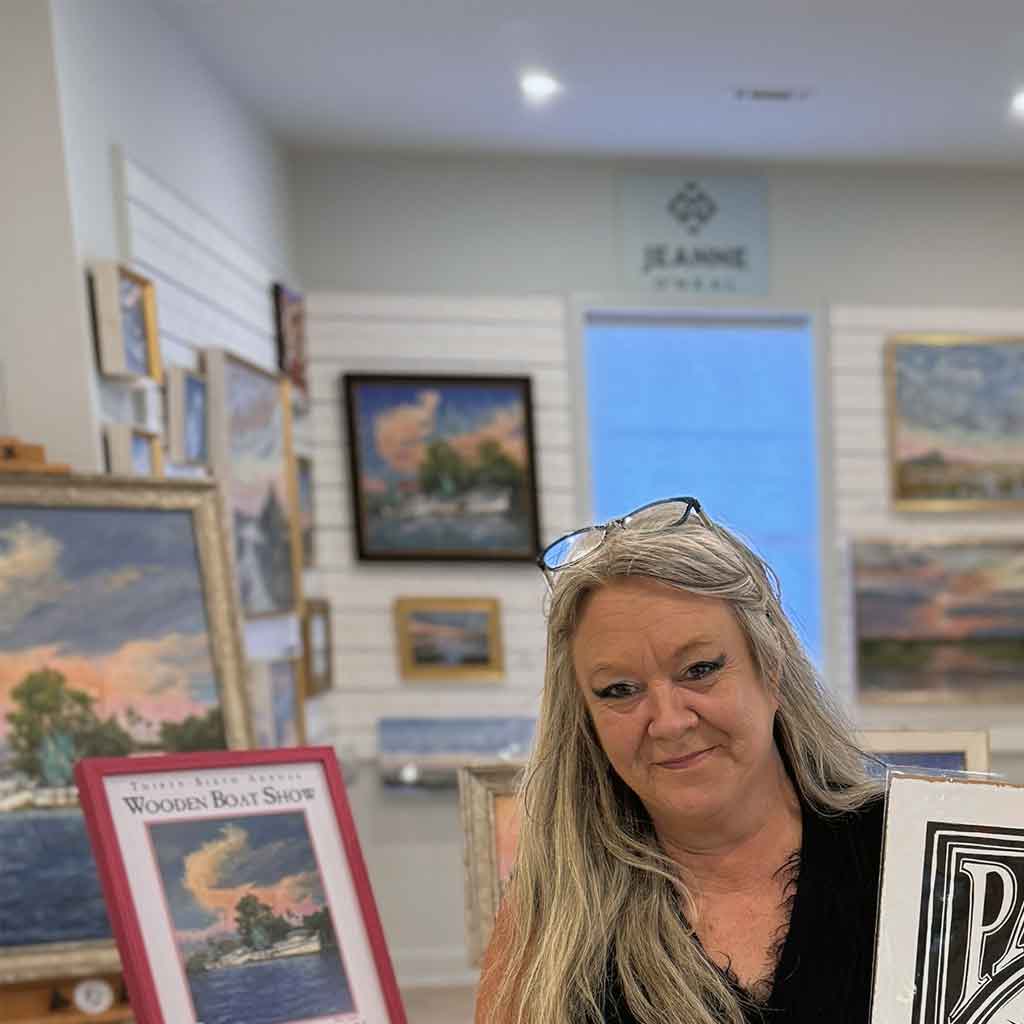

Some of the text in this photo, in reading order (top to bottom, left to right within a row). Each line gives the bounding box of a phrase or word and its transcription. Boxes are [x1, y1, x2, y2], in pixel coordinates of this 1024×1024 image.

[122, 785, 316, 815] WOODEN BOAT SHOW
